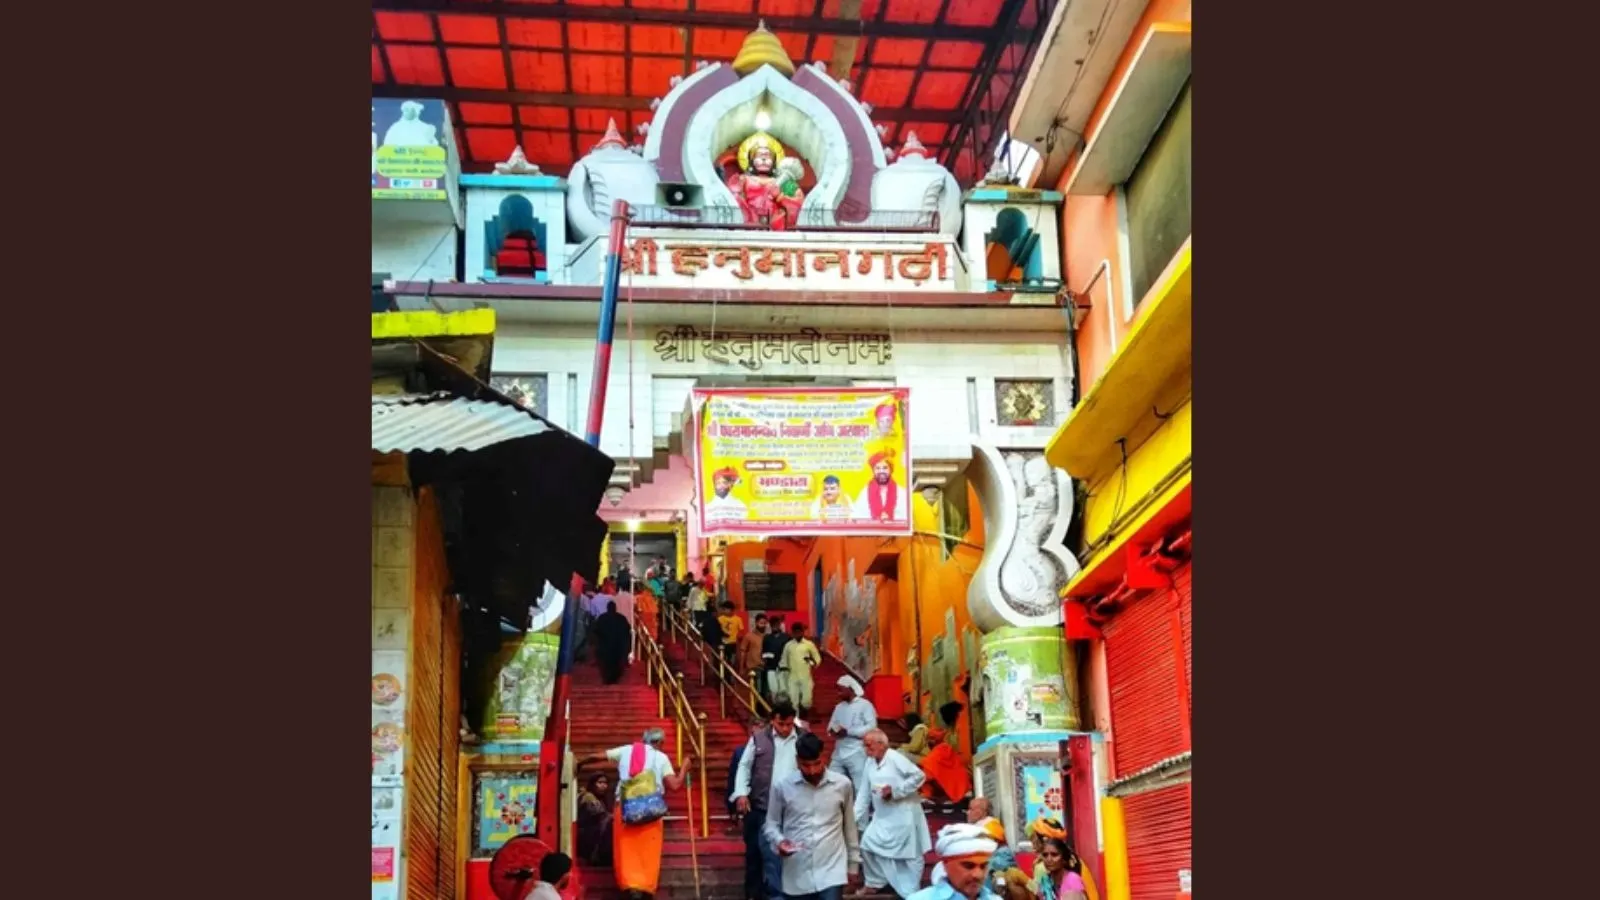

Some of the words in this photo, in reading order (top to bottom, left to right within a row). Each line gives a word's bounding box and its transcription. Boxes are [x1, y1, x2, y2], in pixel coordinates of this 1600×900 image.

[653, 325, 698, 363] श्री
[700, 327, 822, 371] हनुमते
[825, 332, 893, 365] नमः
